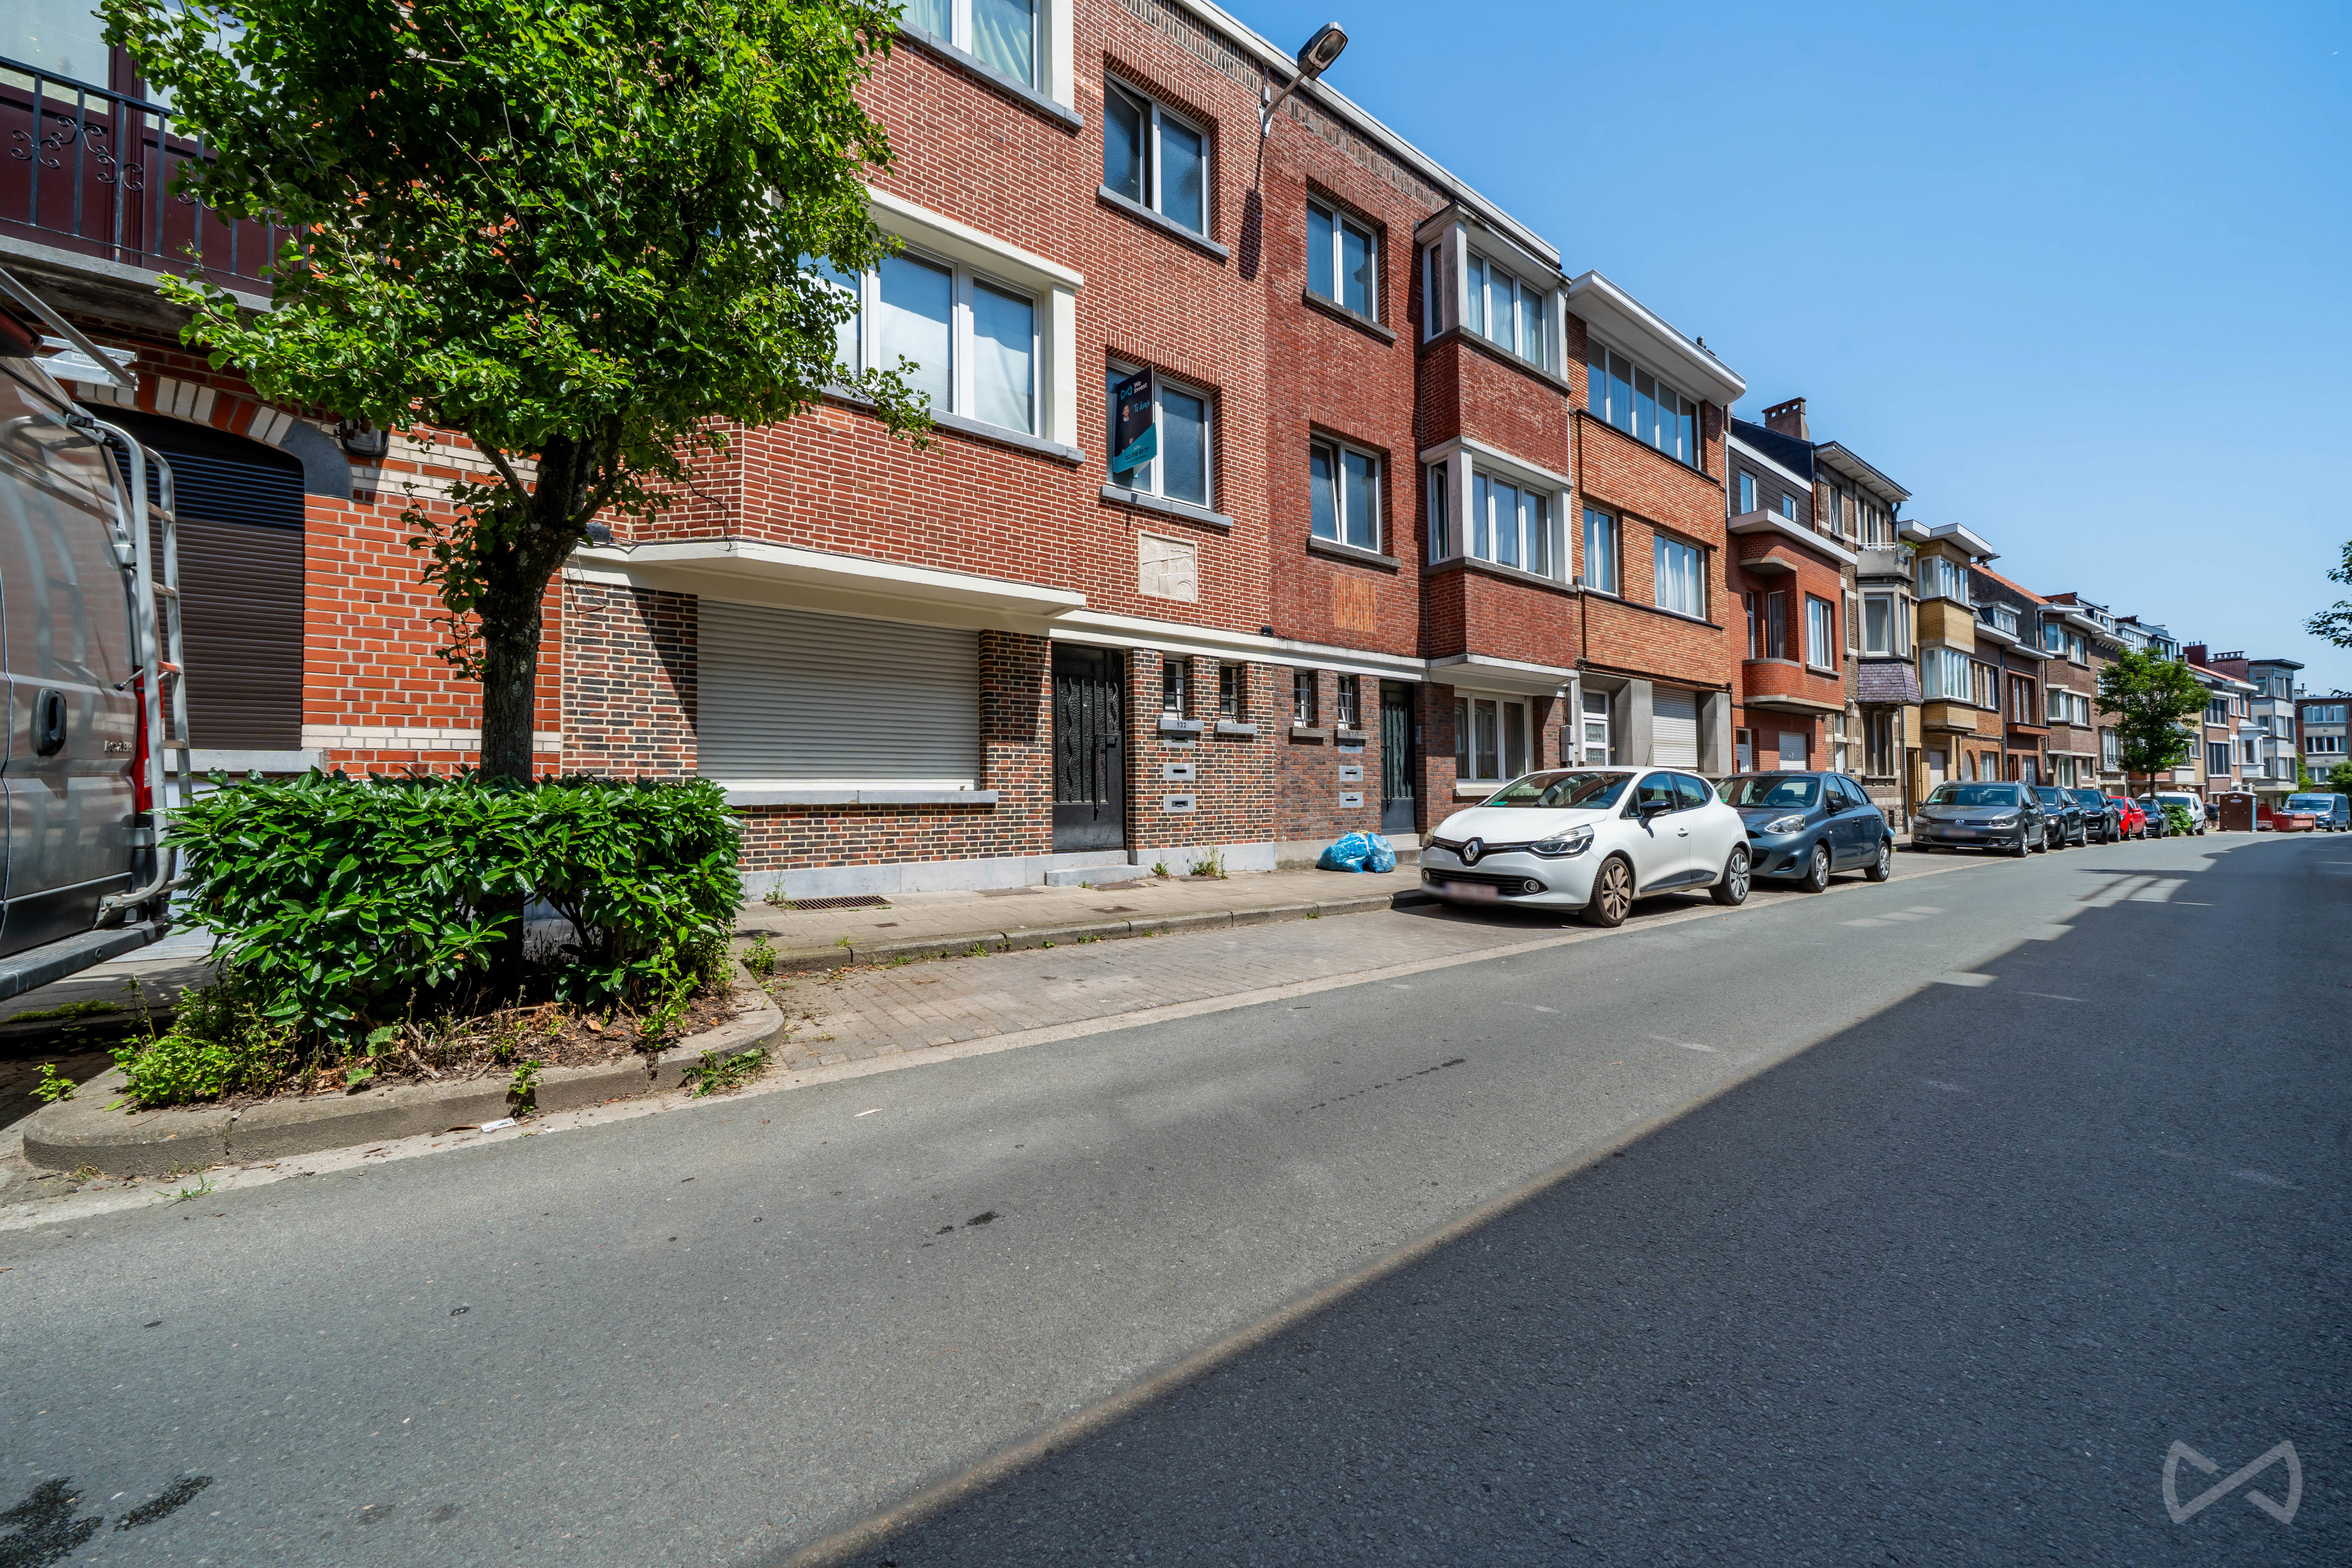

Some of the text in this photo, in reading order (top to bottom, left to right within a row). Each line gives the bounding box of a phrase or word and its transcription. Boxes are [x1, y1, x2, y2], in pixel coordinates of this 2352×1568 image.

[1134, 383, 1148, 393] Invest
[1133, 400, 1150, 413] Te koop
[104, 741, 132, 752] BOXER
